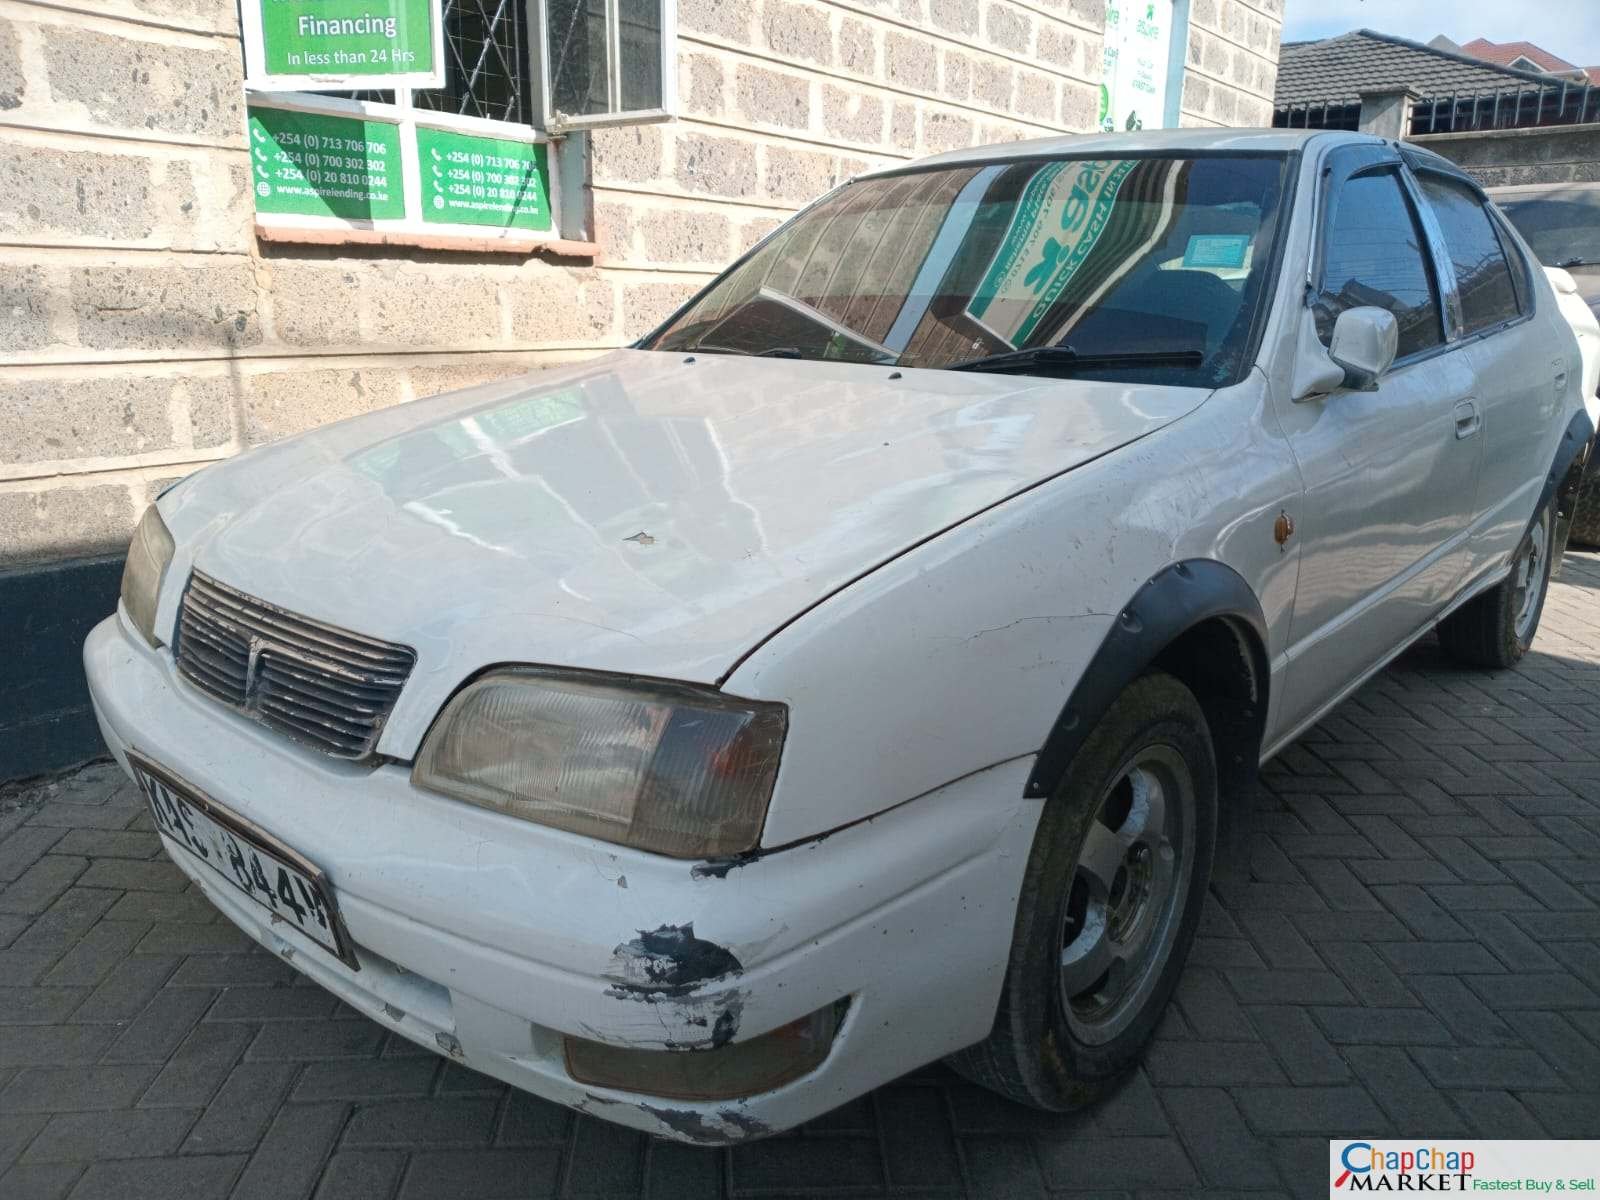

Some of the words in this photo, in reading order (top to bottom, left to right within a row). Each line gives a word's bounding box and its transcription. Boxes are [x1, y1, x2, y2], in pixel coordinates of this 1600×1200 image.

[298, 13, 397, 38] Financing
[287, 52, 300, 65] In
[304, 51, 330, 65] less
[335, 50, 366, 64] than
[370, 49, 387, 63] 24
[392, 49, 415, 62] Hrs
[272, 132, 300, 145] +254
[303, 134, 319, 150] (0)
[322, 136, 342, 150] 713
[345, 139, 365, 152] 706
[366, 141, 387, 155] 706
[273, 150, 301, 164] +254
[304, 153, 320, 167] (0)
[323, 155, 343, 168] 700
[345, 158, 365, 170] 302
[366, 159, 386, 172] 302
[446, 151, 470, 164] +254
[471, 153, 484, 168] (0)
[486, 156, 502, 167] 713
[503, 158, 520, 170] 706
[275, 168, 304, 180] +254
[306, 169, 321, 184] (0)
[324, 171, 337, 183] 20
[340, 173, 359, 185] 810
[361, 175, 388, 187] 0244
[447, 168, 470, 180] +254
[471, 170, 484, 184] (0)
[486, 172, 503, 184] 700
[448, 184, 471, 195] +254
[472, 185, 485, 198] (0)
[486, 187, 498, 198] 20
